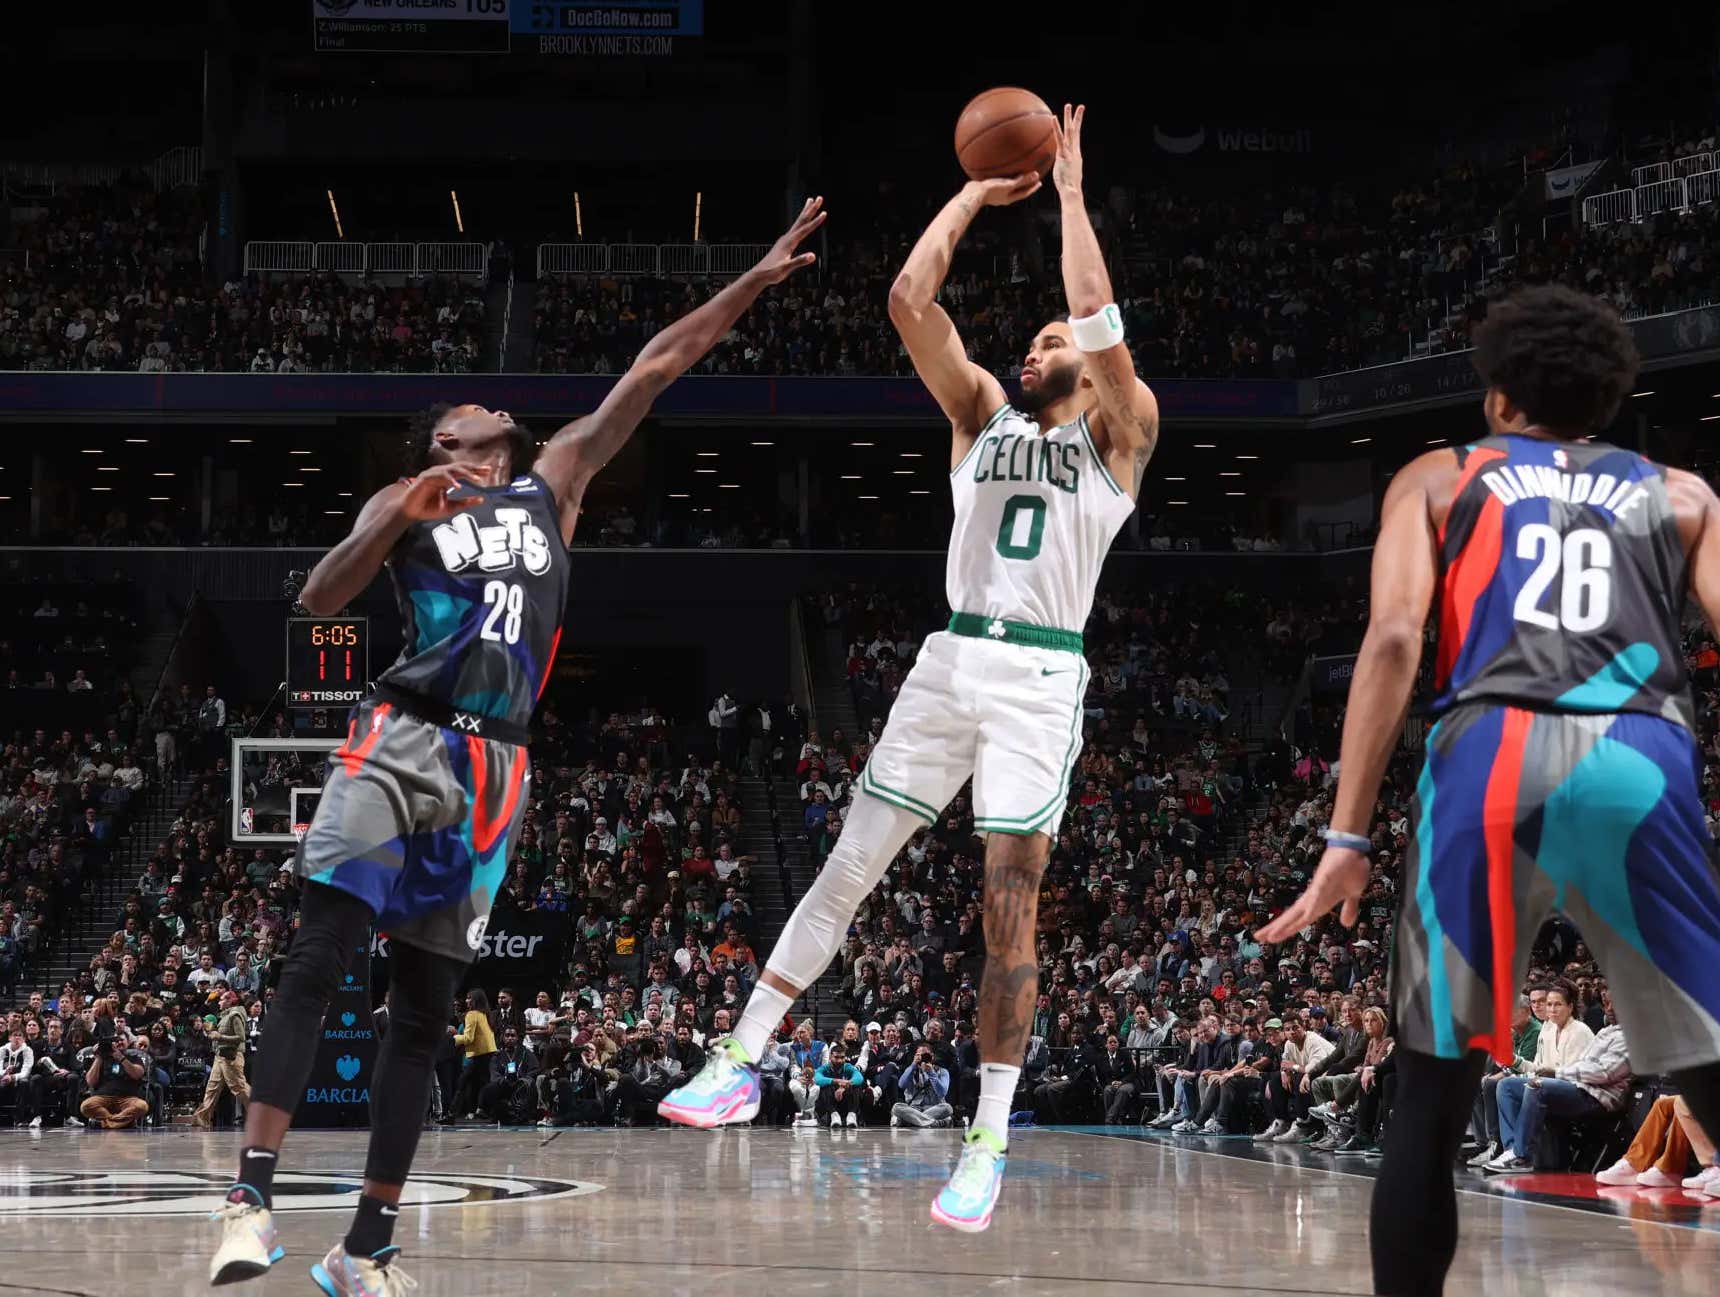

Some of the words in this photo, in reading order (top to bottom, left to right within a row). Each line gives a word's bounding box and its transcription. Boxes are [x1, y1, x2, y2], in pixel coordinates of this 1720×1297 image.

[567, 9, 673, 27] DocGoNow.com
[319, 38, 345, 48] Final
[539, 35, 673, 56] BROOKLYNNETS.COM
[1217, 128, 1312, 152] Webull
[996, 494, 1047, 560] 0
[432, 508, 551, 576] NETS
[1513, 523, 1612, 633] 26
[480, 580, 523, 645] 28
[312, 625, 357, 646] 6:05
[311, 691, 363, 700] TISSOT
[324, 1030, 373, 1040] BARCLAYS
